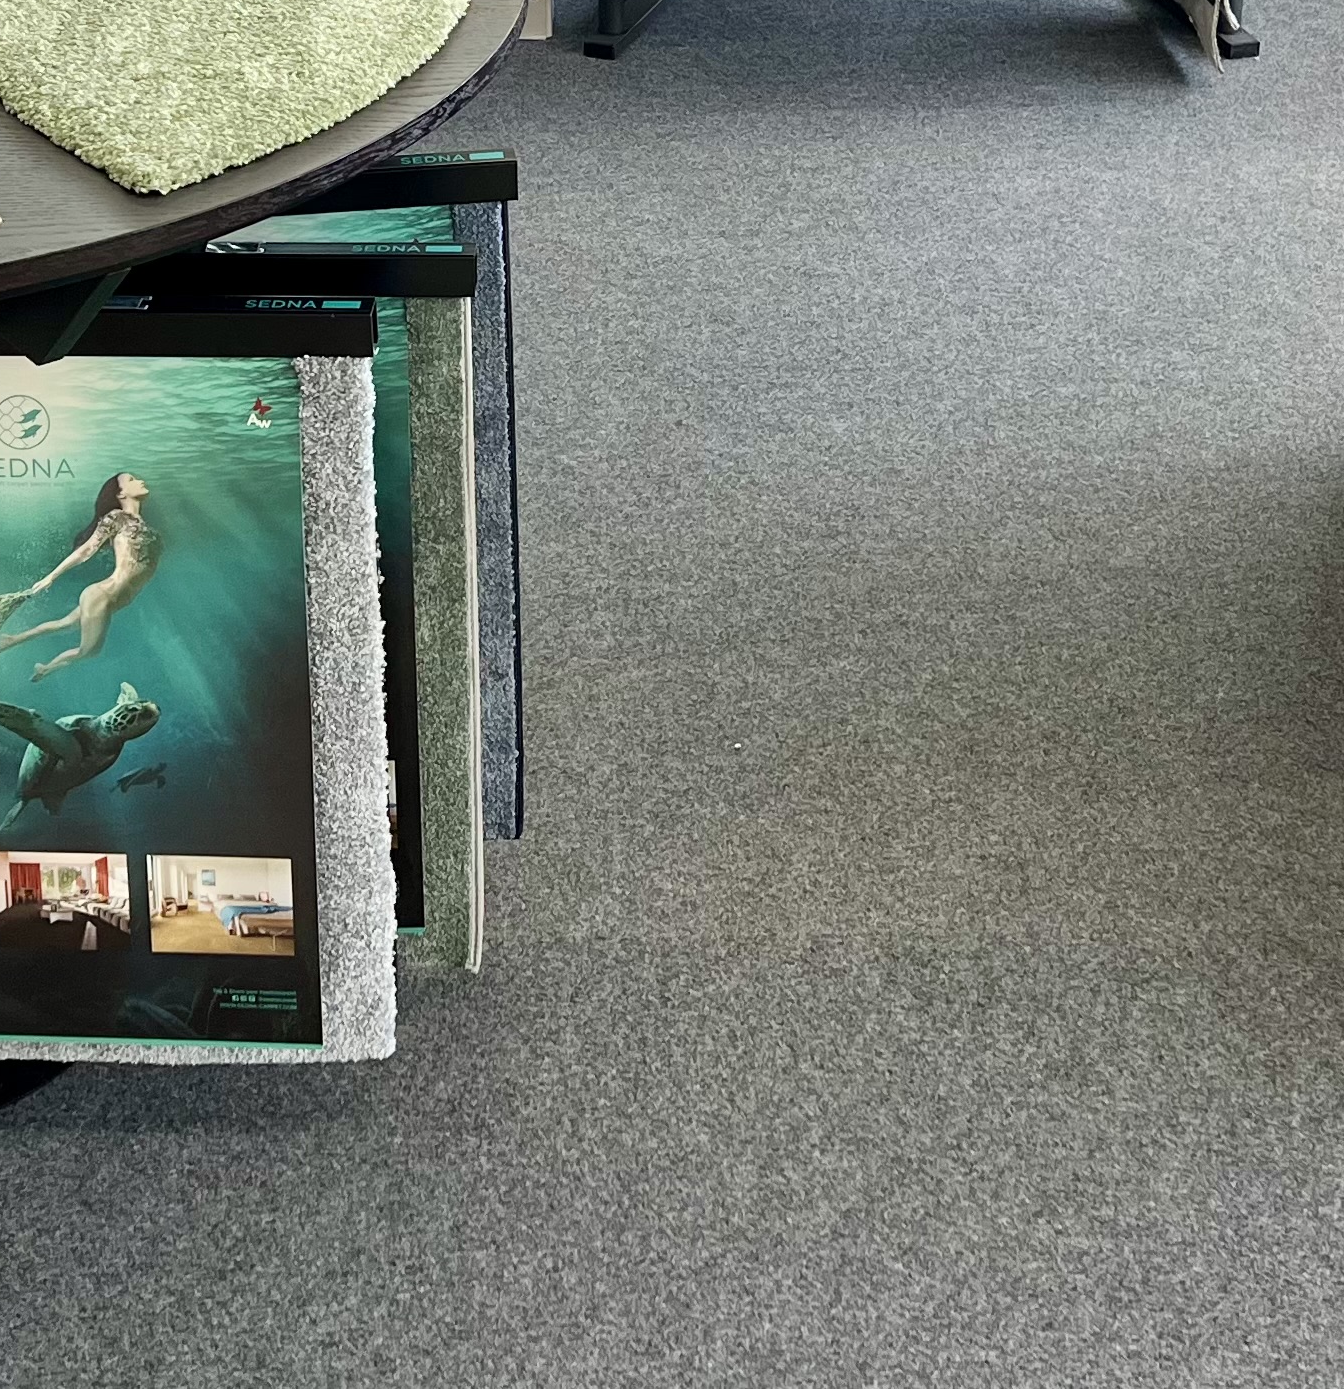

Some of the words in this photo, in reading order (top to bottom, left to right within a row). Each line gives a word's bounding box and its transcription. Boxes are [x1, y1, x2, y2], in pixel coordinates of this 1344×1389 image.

[400, 153, 466, 165] SEDNA
[351, 244, 421, 254] SEDNA
[245, 299, 317, 310] SEDNA
